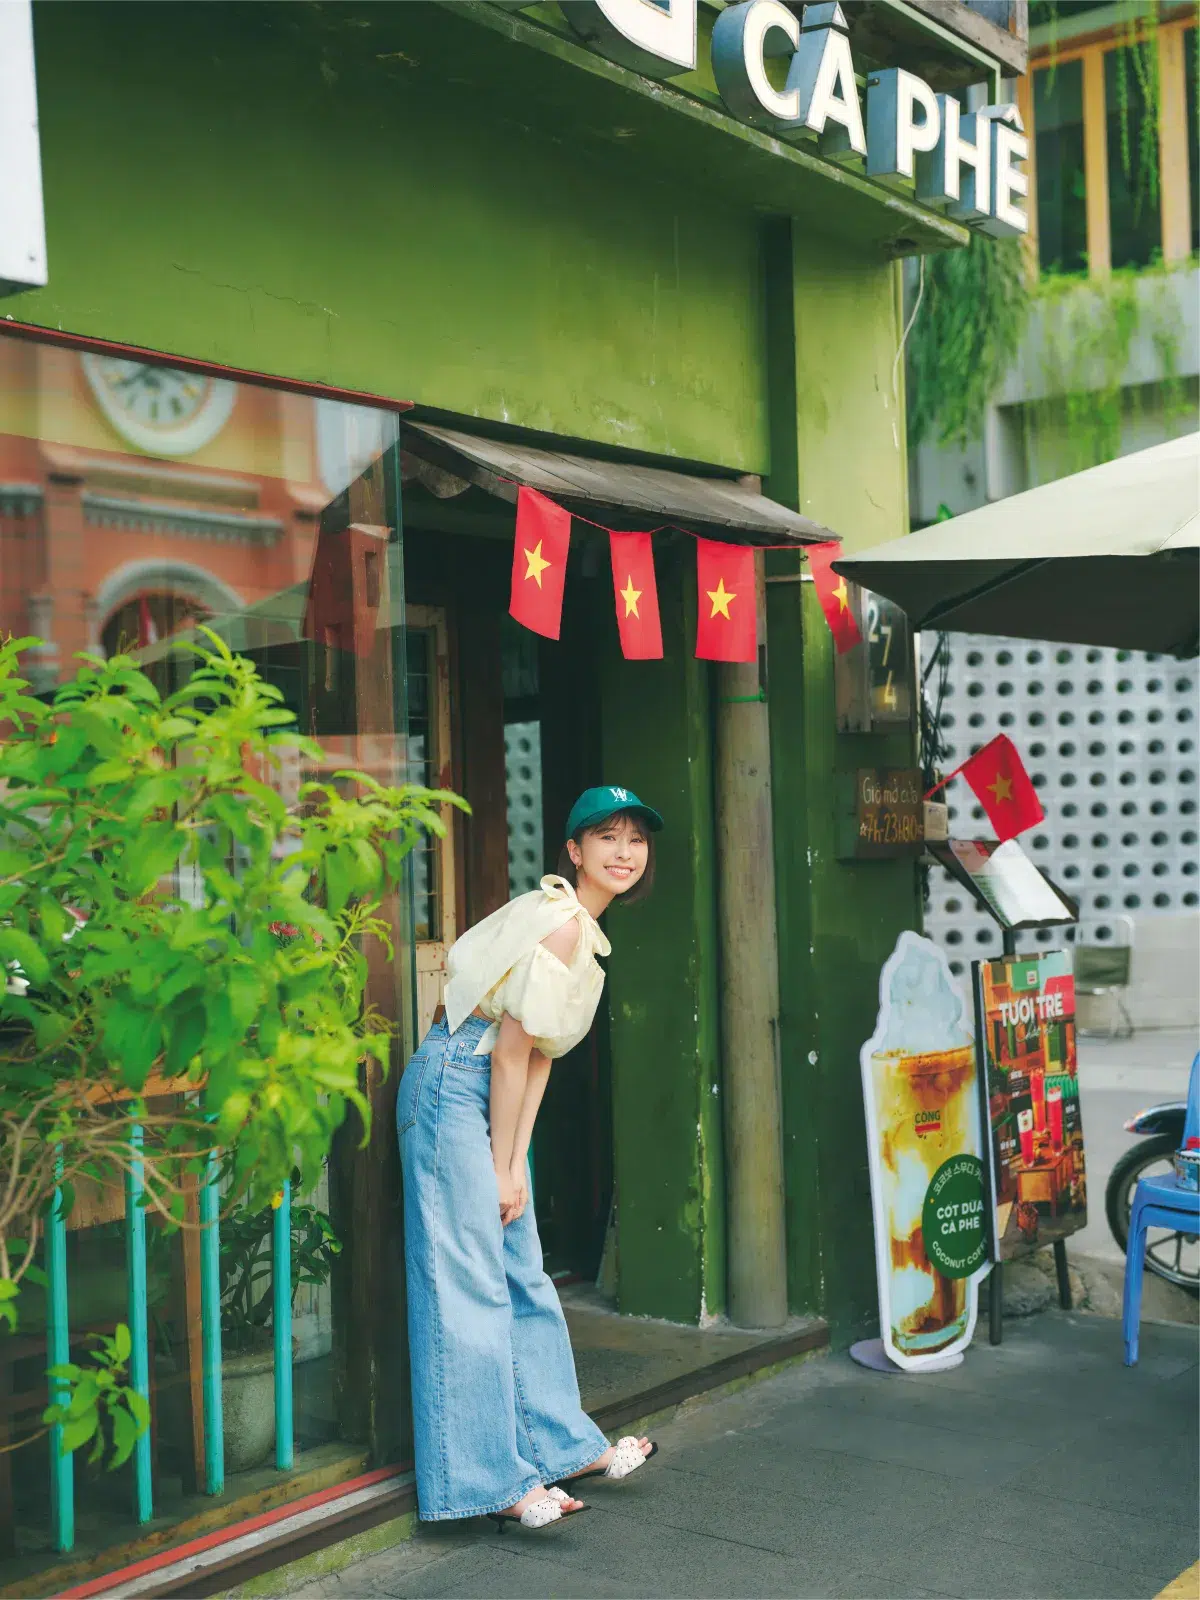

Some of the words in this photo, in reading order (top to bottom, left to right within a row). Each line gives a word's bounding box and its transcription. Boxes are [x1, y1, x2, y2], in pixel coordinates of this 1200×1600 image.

[893, 67, 1028, 234] PHÊ
[953, 1161, 975, 1176] 스무디
[932, 1240, 966, 1269] COCONUT
[966, 1235, 987, 1265] COFF
